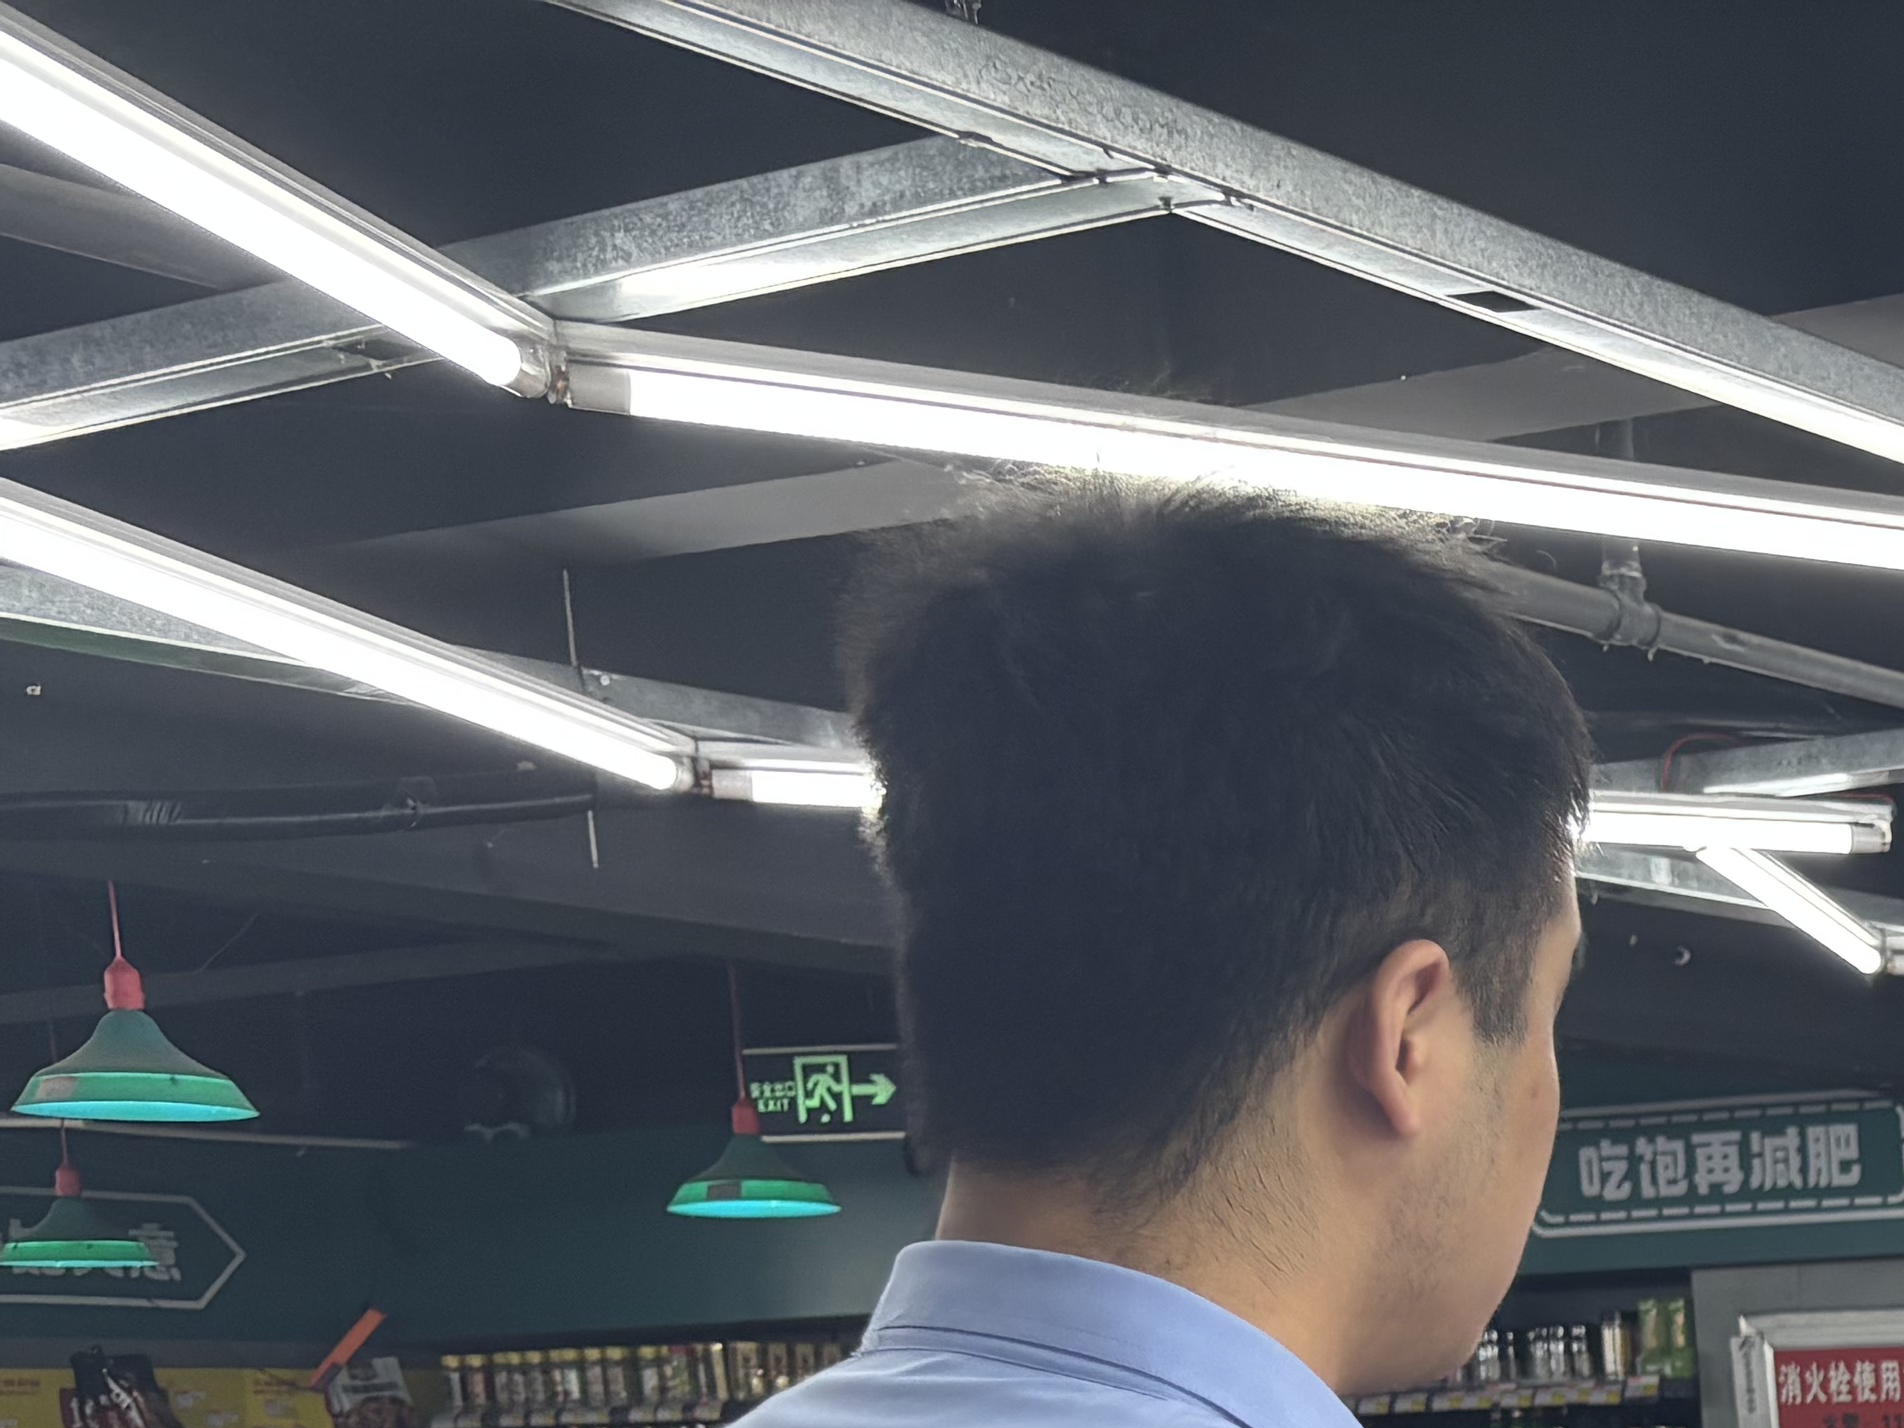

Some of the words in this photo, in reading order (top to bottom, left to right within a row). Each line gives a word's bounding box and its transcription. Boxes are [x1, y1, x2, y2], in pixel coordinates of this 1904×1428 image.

[1578, 1124, 1862, 1200] 吃饱再减肥
